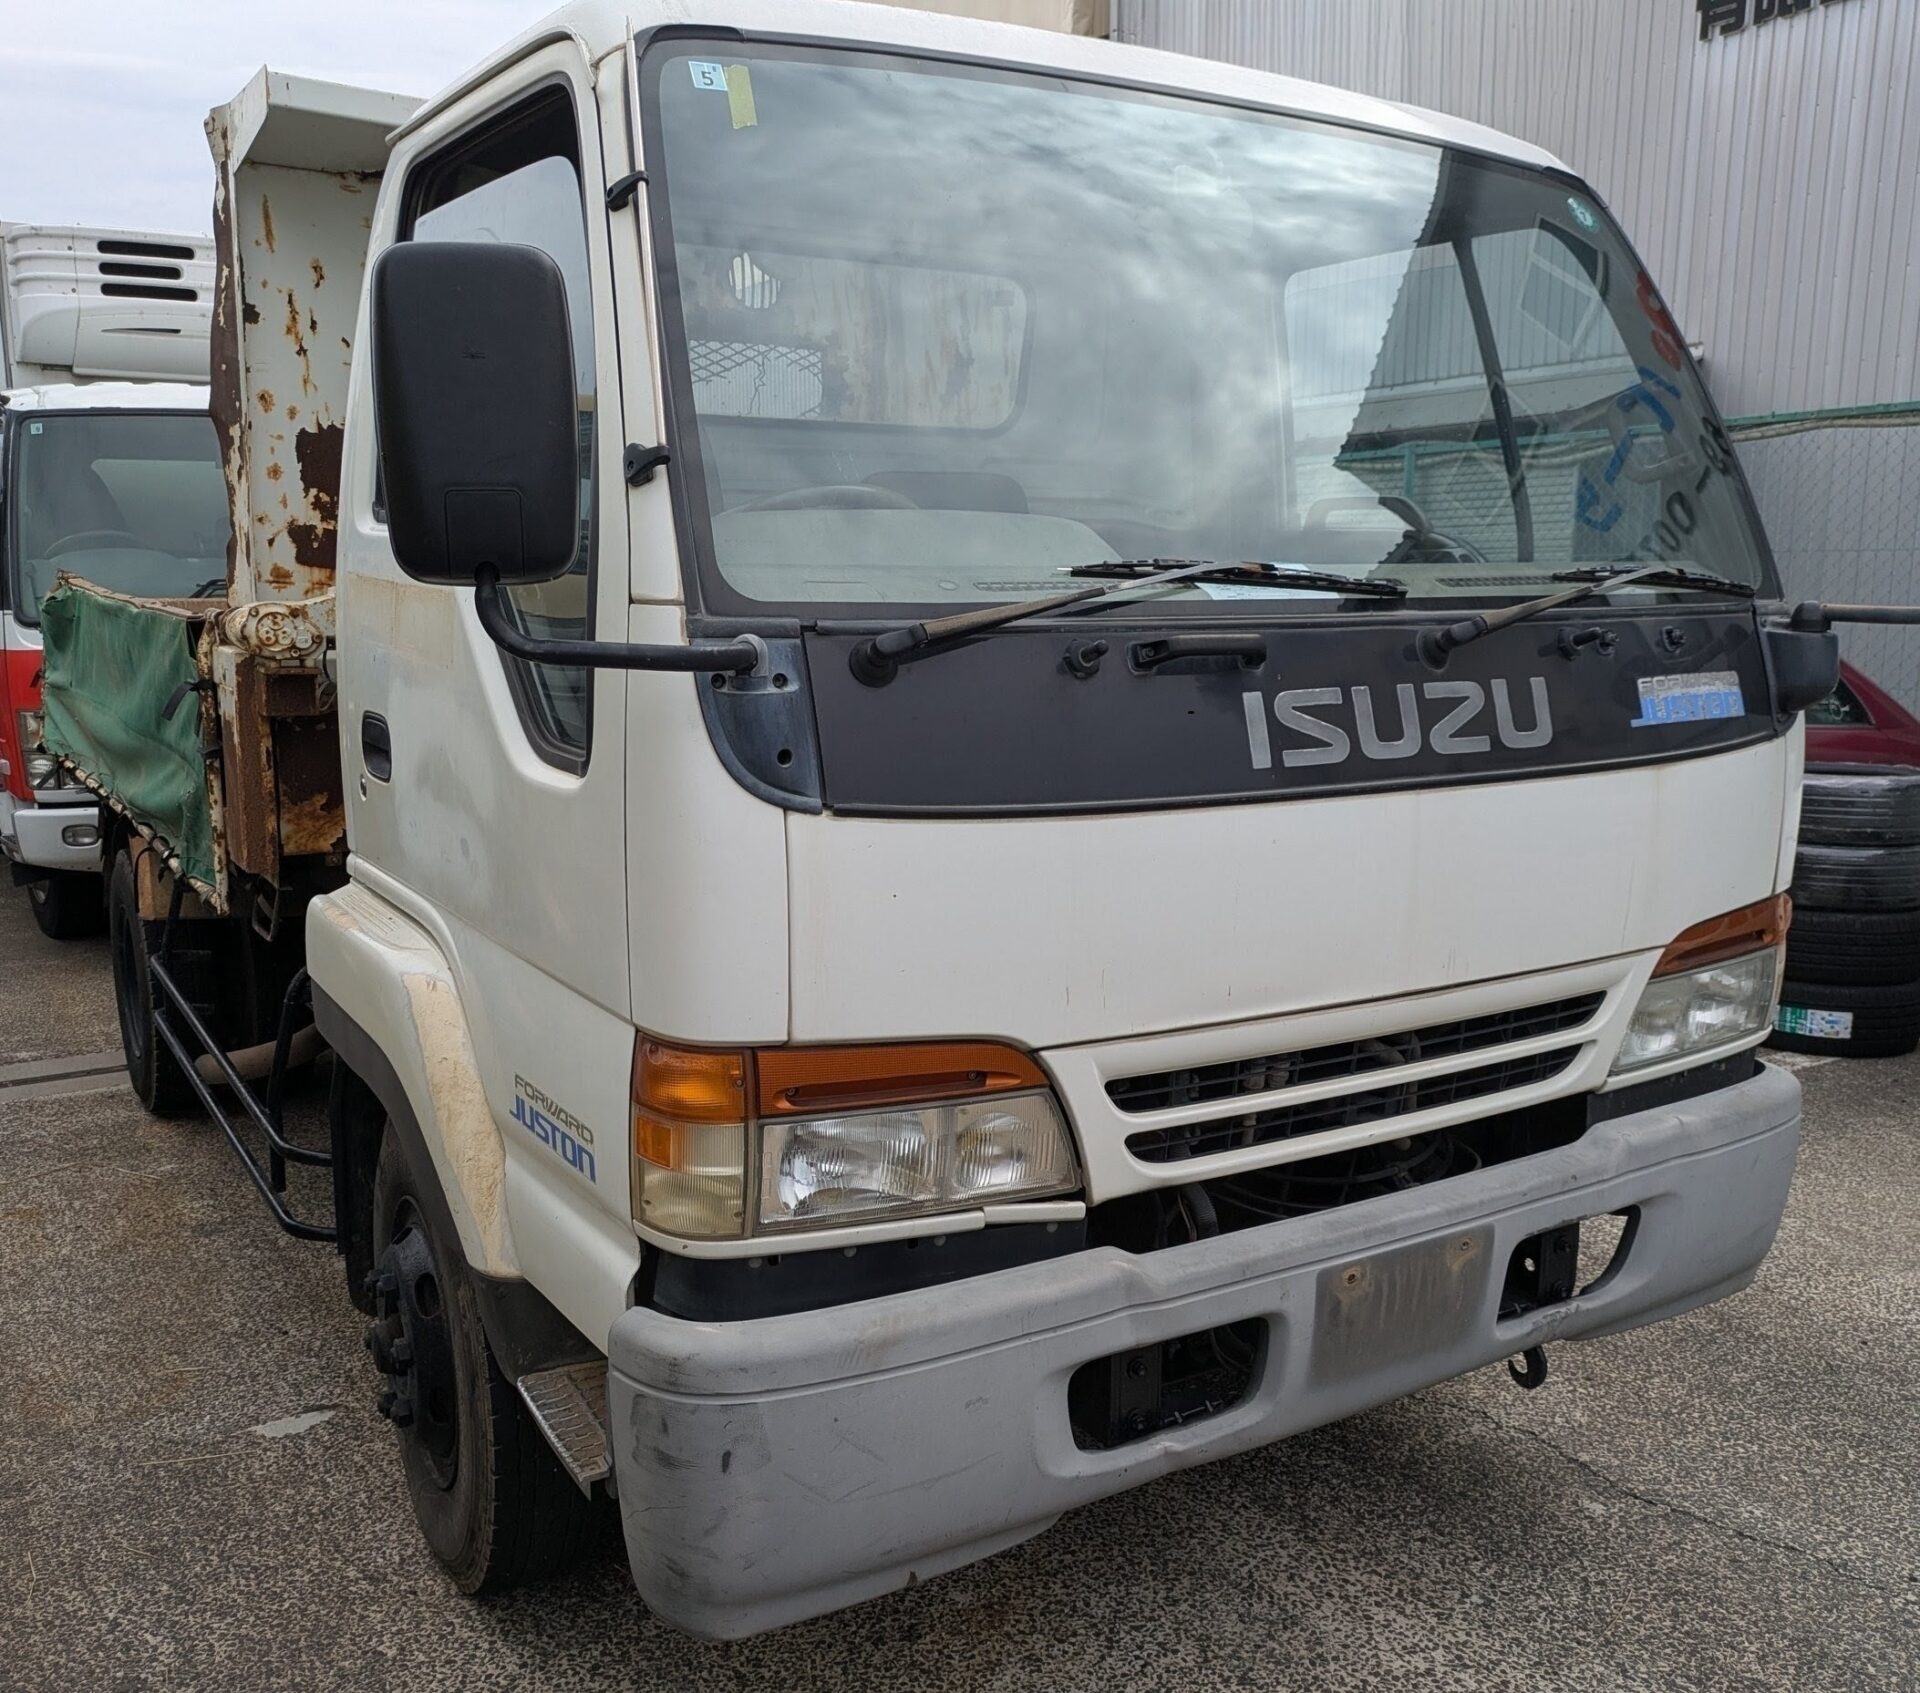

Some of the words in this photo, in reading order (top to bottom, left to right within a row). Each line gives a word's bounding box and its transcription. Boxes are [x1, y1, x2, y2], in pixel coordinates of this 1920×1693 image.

[1242, 676, 1553, 770] ISUZU
[509, 1094, 596, 1184] JUSTON
[514, 1073, 594, 1145] FORWARD
